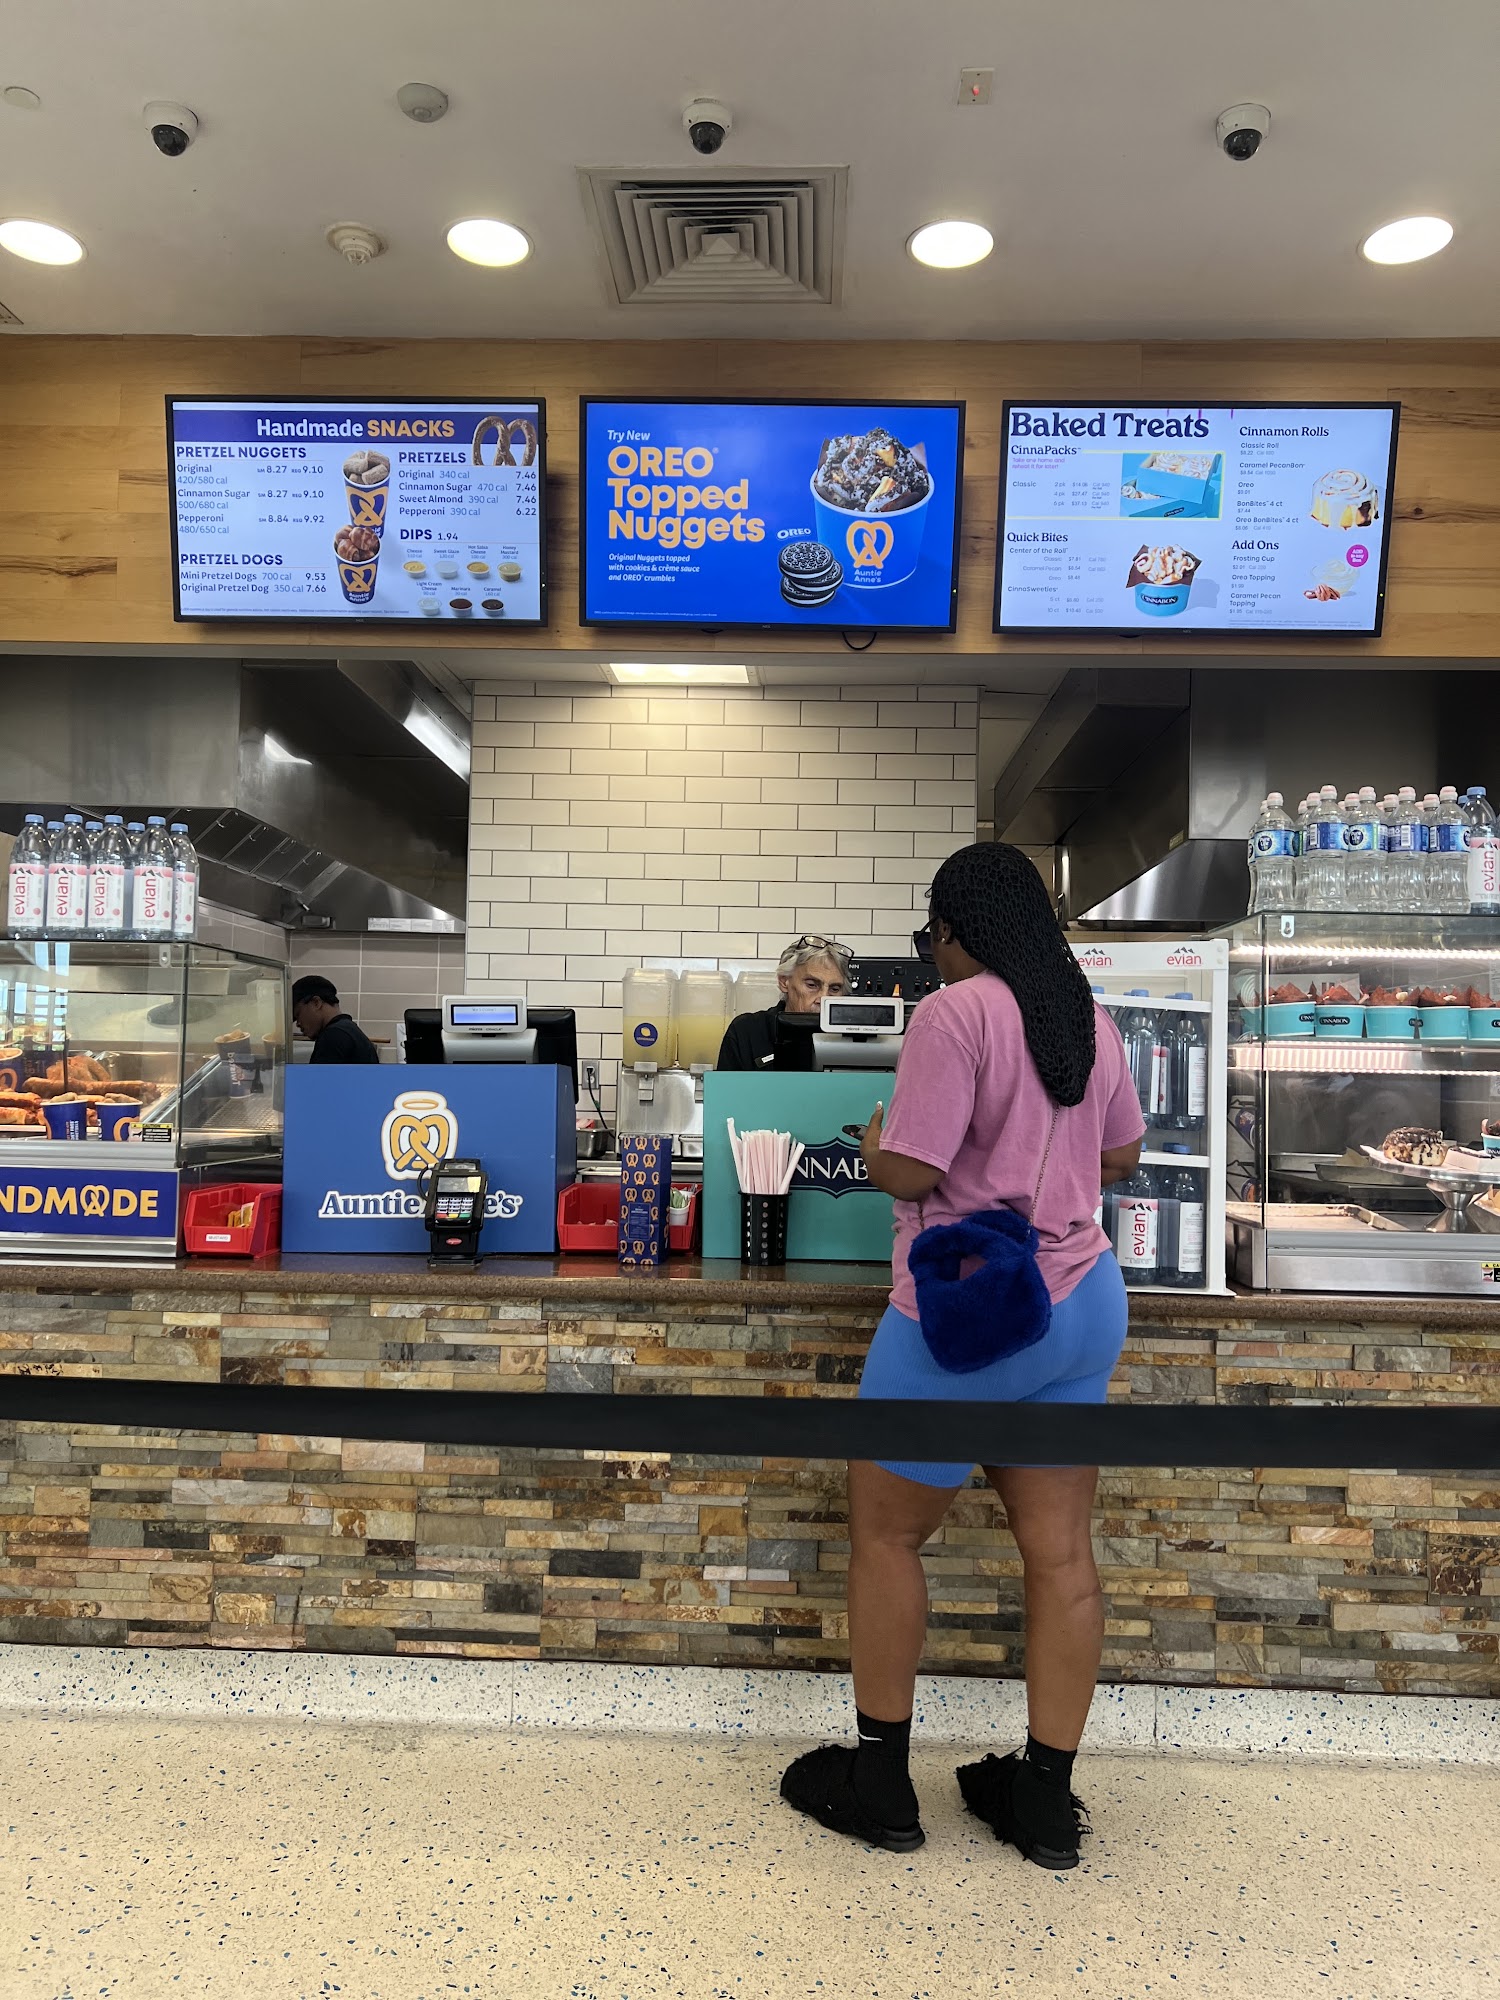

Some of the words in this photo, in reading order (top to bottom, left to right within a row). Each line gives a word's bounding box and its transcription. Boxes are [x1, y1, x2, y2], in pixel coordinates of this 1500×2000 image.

[257, 418, 363, 438] Handmade
[367, 419, 456, 438] SNACKS
[1011, 412, 1106, 437] Baked
[1112, 413, 1209, 438] Treats
[608, 430, 624, 442] Try
[627, 430, 650, 440] New
[1240, 427, 1298, 436] Cinnamon
[1301, 427, 1329, 436] Rolls
[177, 447, 235, 457] PRETZEL
[239, 448, 306, 458] NUGGETS
[399, 452, 466, 463] PRETZELS
[177, 464, 212, 474] Original
[177, 476, 214, 484] 420/580
[399, 471, 434, 480] Original
[399, 483, 444, 491] Cinnamon
[446, 483, 472, 493] Sugar
[225, 490, 250, 499] Sugar
[607, 478, 748, 516] Topped
[217, 501, 228, 509] cal
[400, 507, 445, 516] Pepperoni
[179, 514, 223, 523] Pepperoni
[218, 525, 229, 533] cal
[400, 529, 432, 540] DIPS
[608, 510, 765, 549] Nuggets
[777, 528, 811, 539] OREO
[1007, 532, 1039, 542] Quick
[1042, 532, 1068, 542] Bites
[1232, 540, 1254, 549] Add
[1257, 540, 1279, 550] Ons
[181, 554, 238, 564] PRETZEL
[242, 555, 283, 565] DOGS
[609, 553, 636, 562] Original
[637, 554, 665, 562] Nuggets
[666, 555, 690, 563] topped
[235, 572, 257, 582] Dogs
[182, 584, 216, 593] Original
[252, 584, 269, 594] Dog
[1484, 852, 1495, 892] evian
[15, 876, 25, 915] evian
[56, 876, 68, 916] evian
[95, 877, 105, 916] evian
[144, 878, 156, 918] evian
[1078, 955, 1112, 966] evian
[1167, 954, 1202, 965] evian
[322, 1191, 420, 1215] Auntie
[1133, 1212, 1145, 1256] evian
